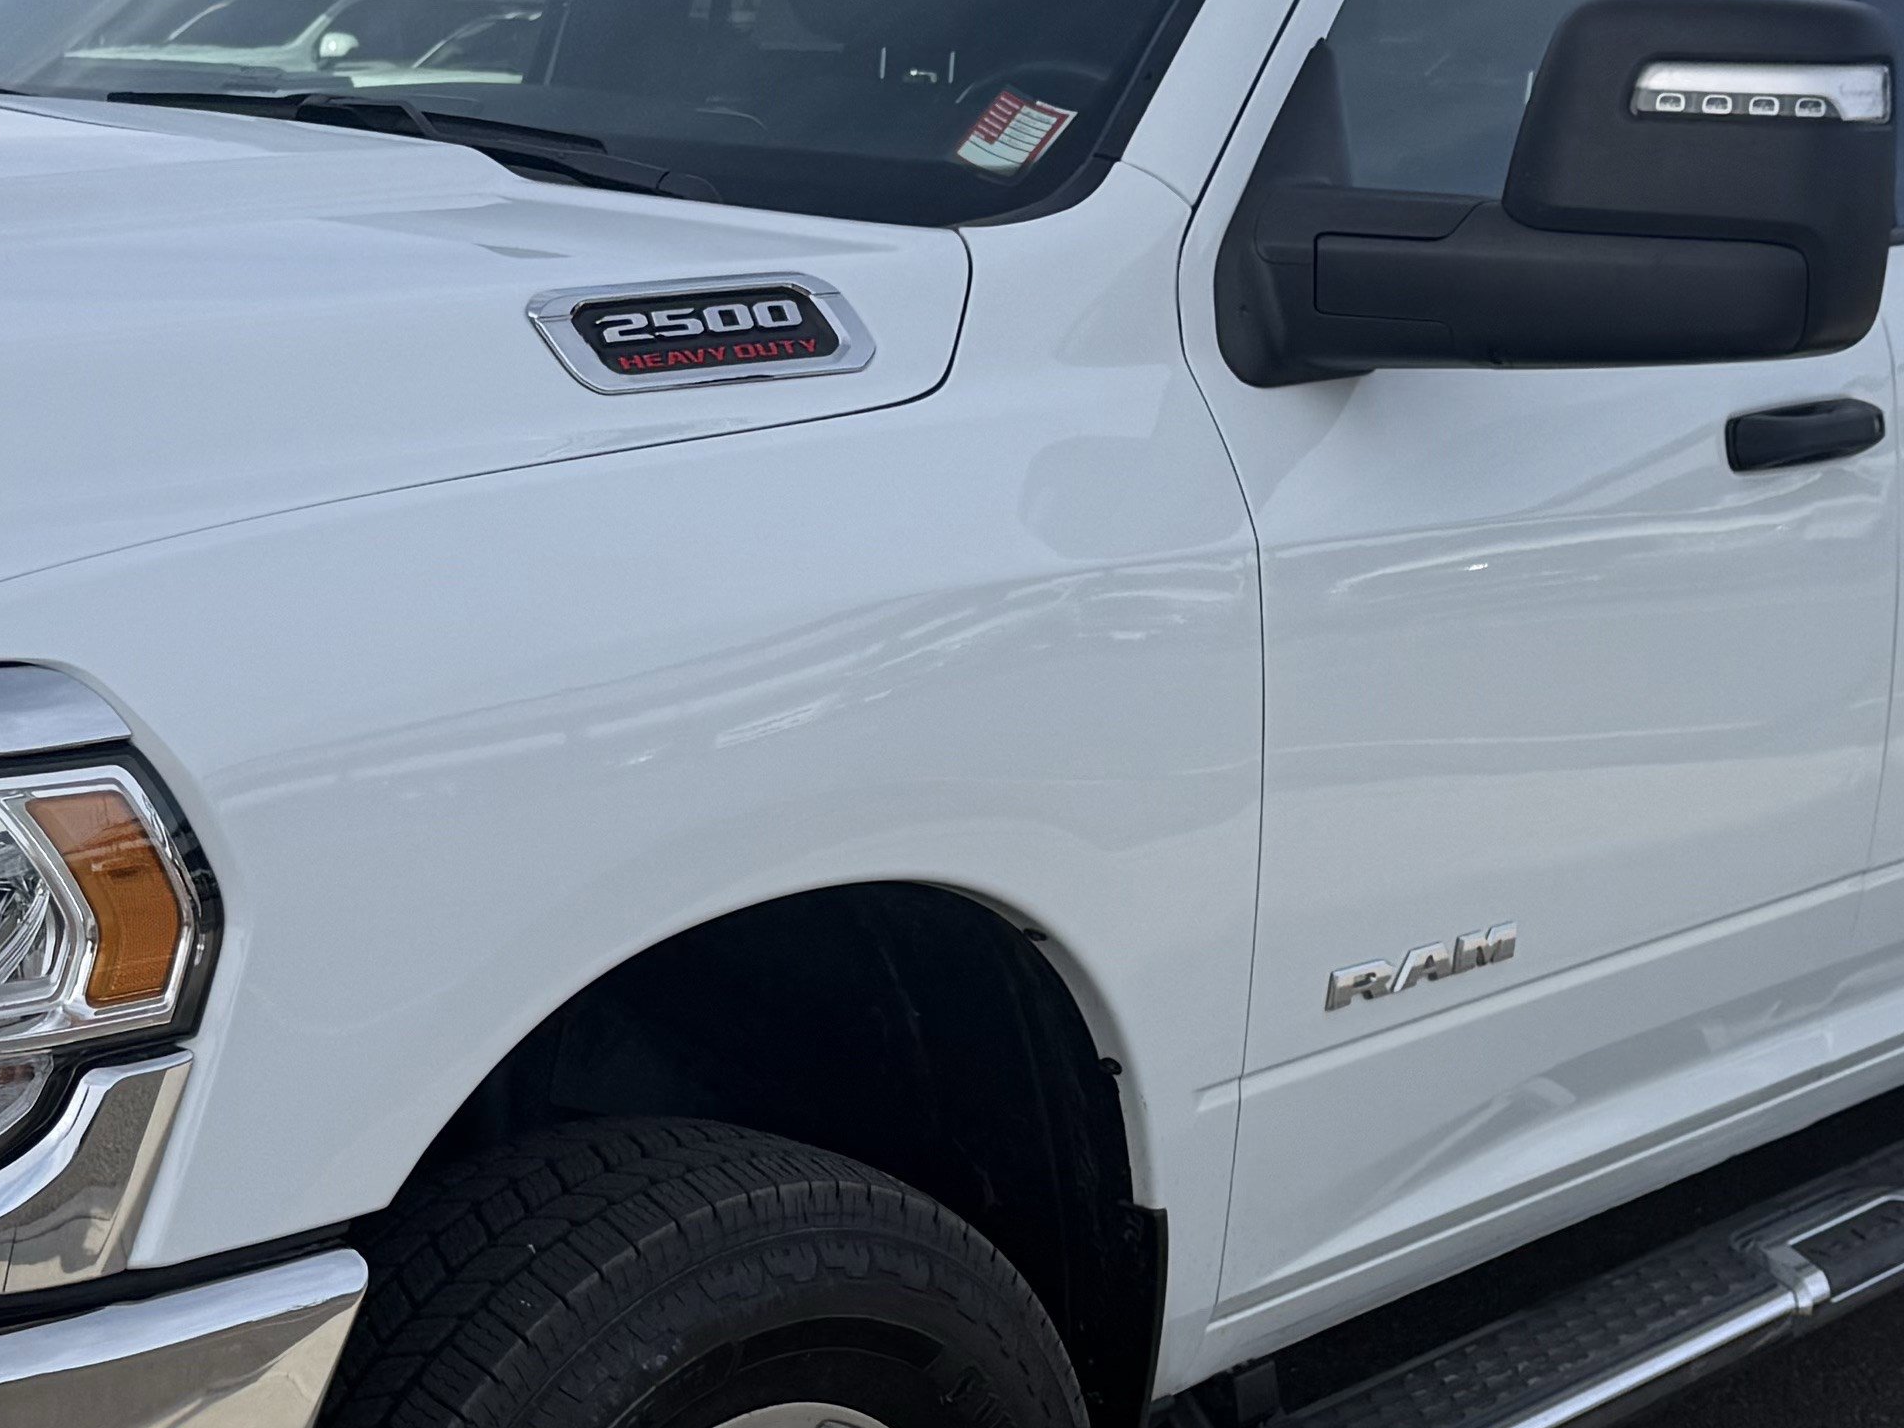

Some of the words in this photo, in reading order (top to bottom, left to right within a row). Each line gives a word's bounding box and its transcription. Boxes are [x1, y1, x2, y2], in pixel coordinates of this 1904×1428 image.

[598, 299, 803, 344] 2500
[618, 345, 727, 372] HEAVY
[734, 337, 818, 360] DUTY
[1324, 921, 1518, 1013] RAM
